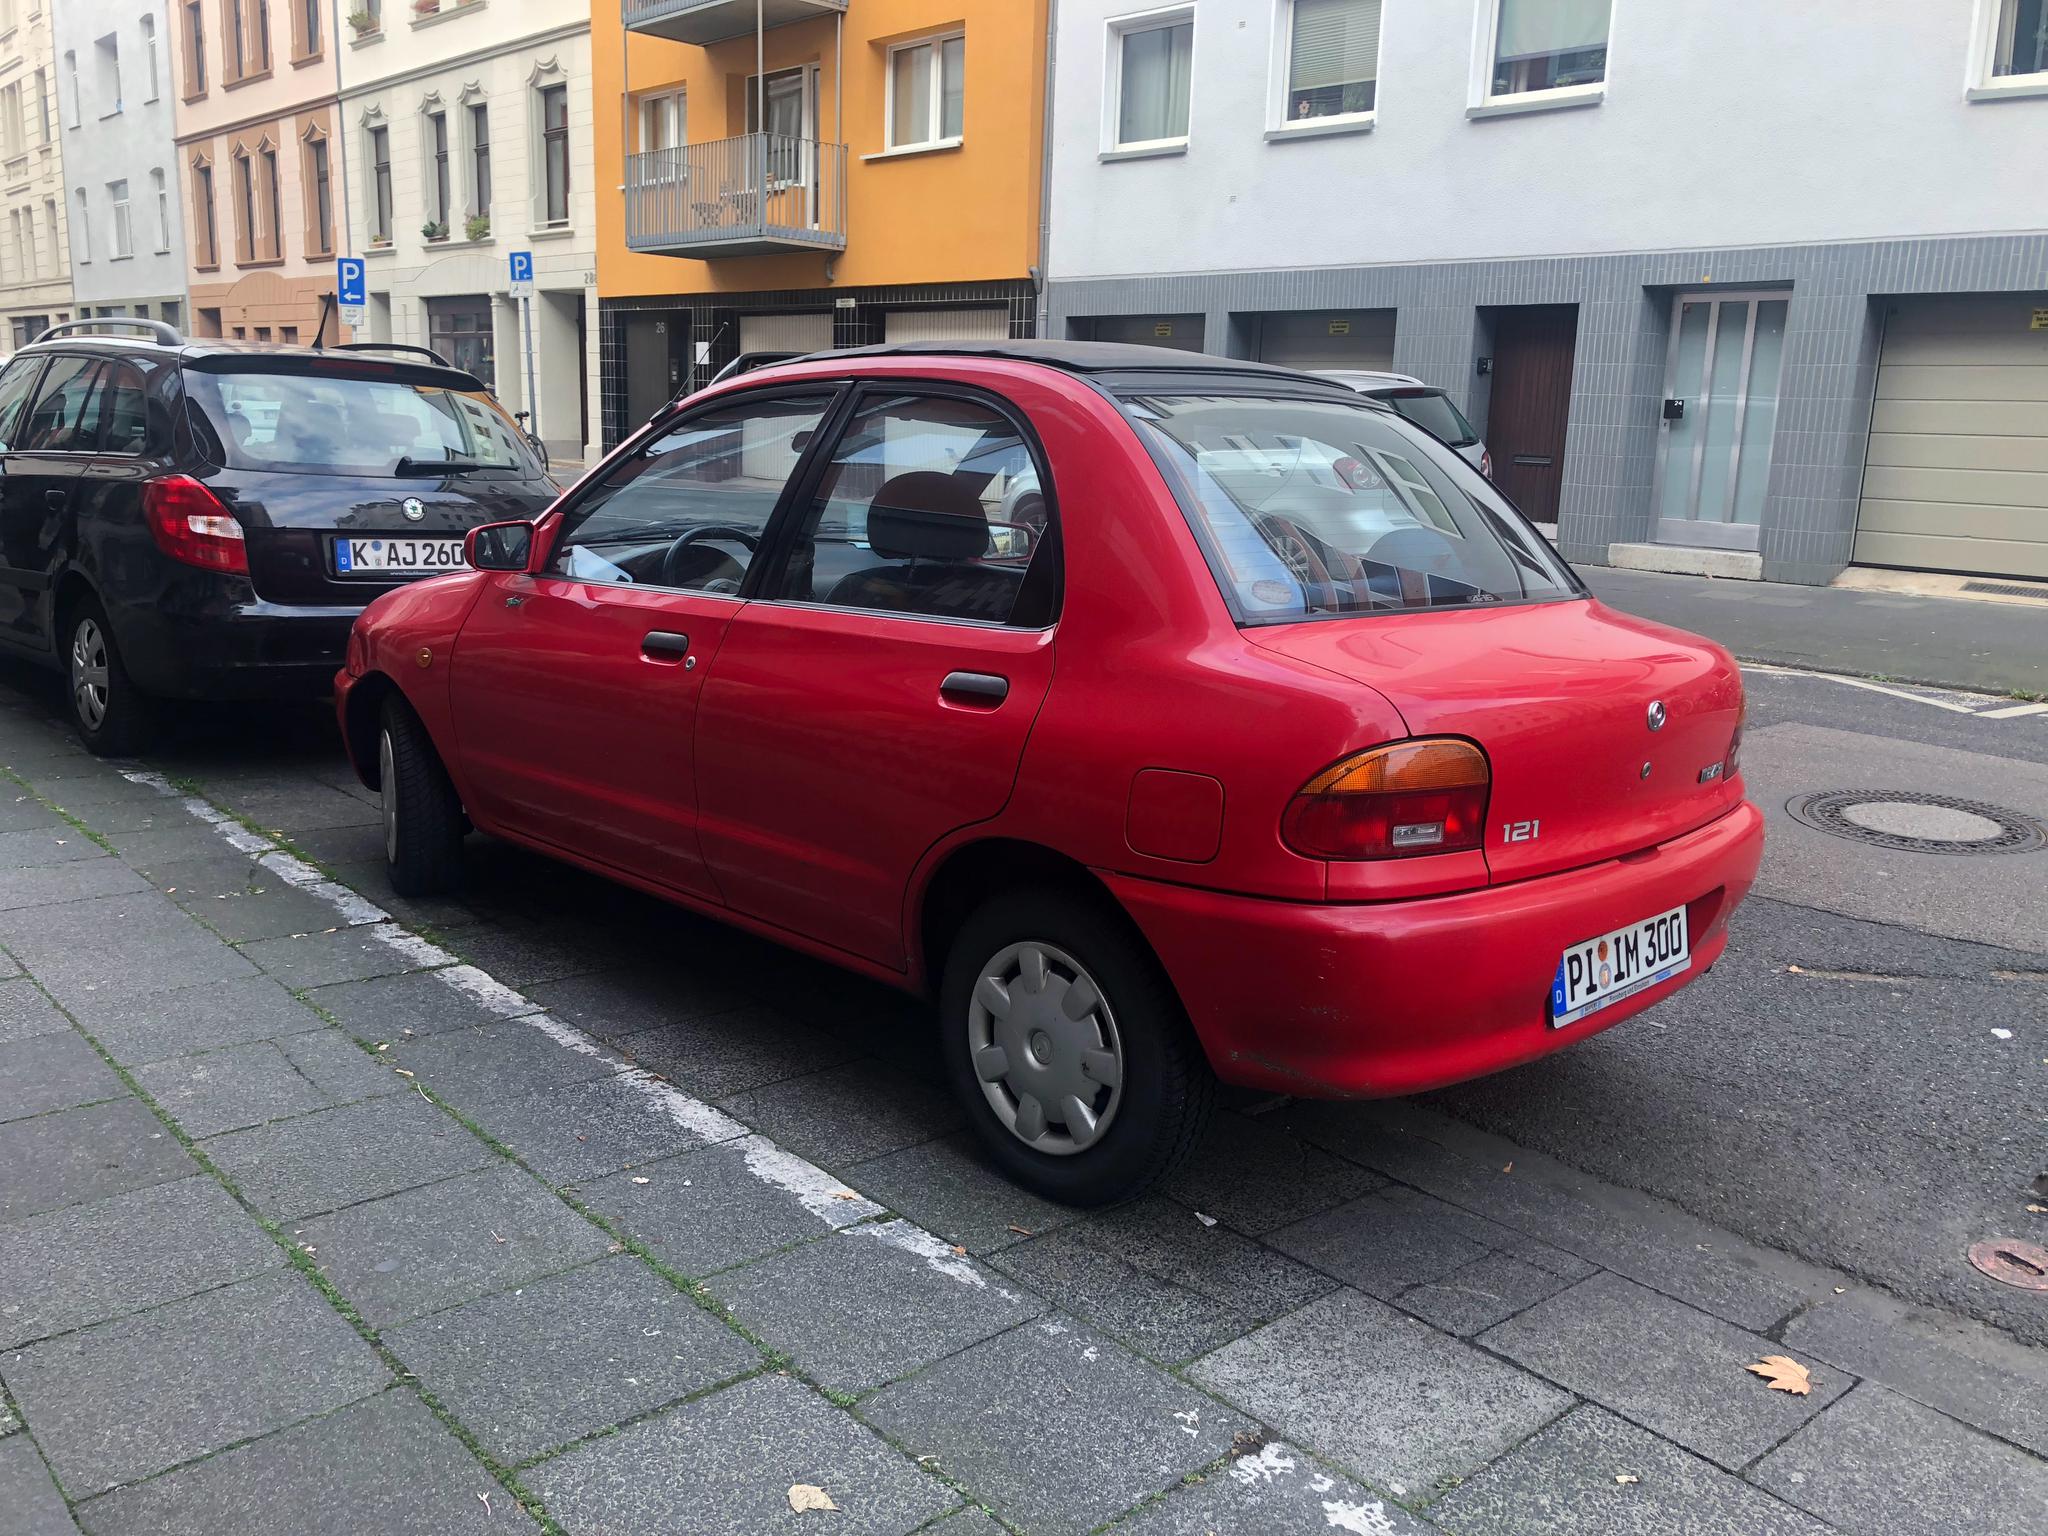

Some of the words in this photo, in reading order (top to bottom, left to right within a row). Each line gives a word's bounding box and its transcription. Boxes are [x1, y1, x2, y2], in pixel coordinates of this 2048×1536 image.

[342, 262, 360, 290] P
[514, 255, 527, 280] P
[656, 321, 665, 334] 26
[341, 557, 347, 565] D
[352, 542, 369, 566] K
[387, 542, 417, 566] AJ
[422, 542, 465, 566] 260
[1503, 819, 1539, 843] 121
[1567, 948, 1598, 1002] PI
[1614, 930, 1640, 983] IM
[1644, 912, 1683, 968] 300
[1556, 990, 1563, 1004] D
